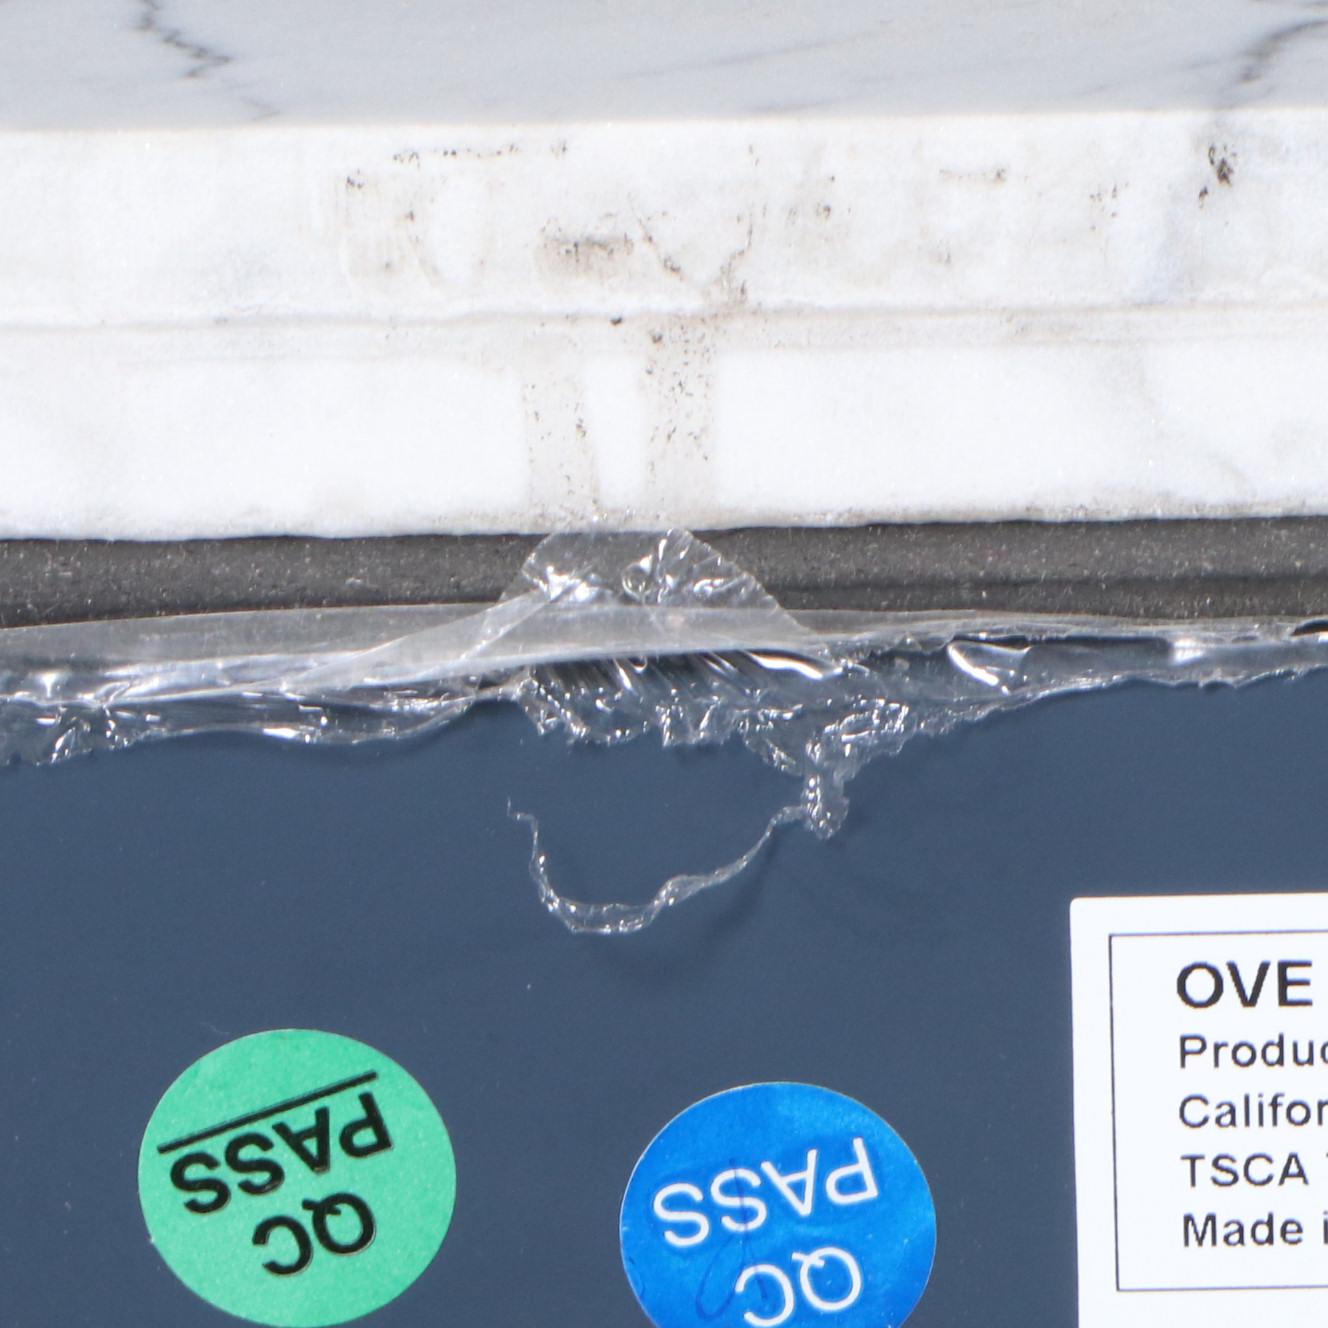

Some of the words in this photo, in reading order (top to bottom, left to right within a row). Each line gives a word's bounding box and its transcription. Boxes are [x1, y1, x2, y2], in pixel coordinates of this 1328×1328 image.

[1177, 961, 1313, 1008] OVE
[170, 1091, 393, 1214] PASS
[1181, 1153, 1309, 1187] TSCA
[652, 1136, 880, 1249] PASS
[252, 1192, 375, 1276] QC
[1184, 1212, 1304, 1247] Made
